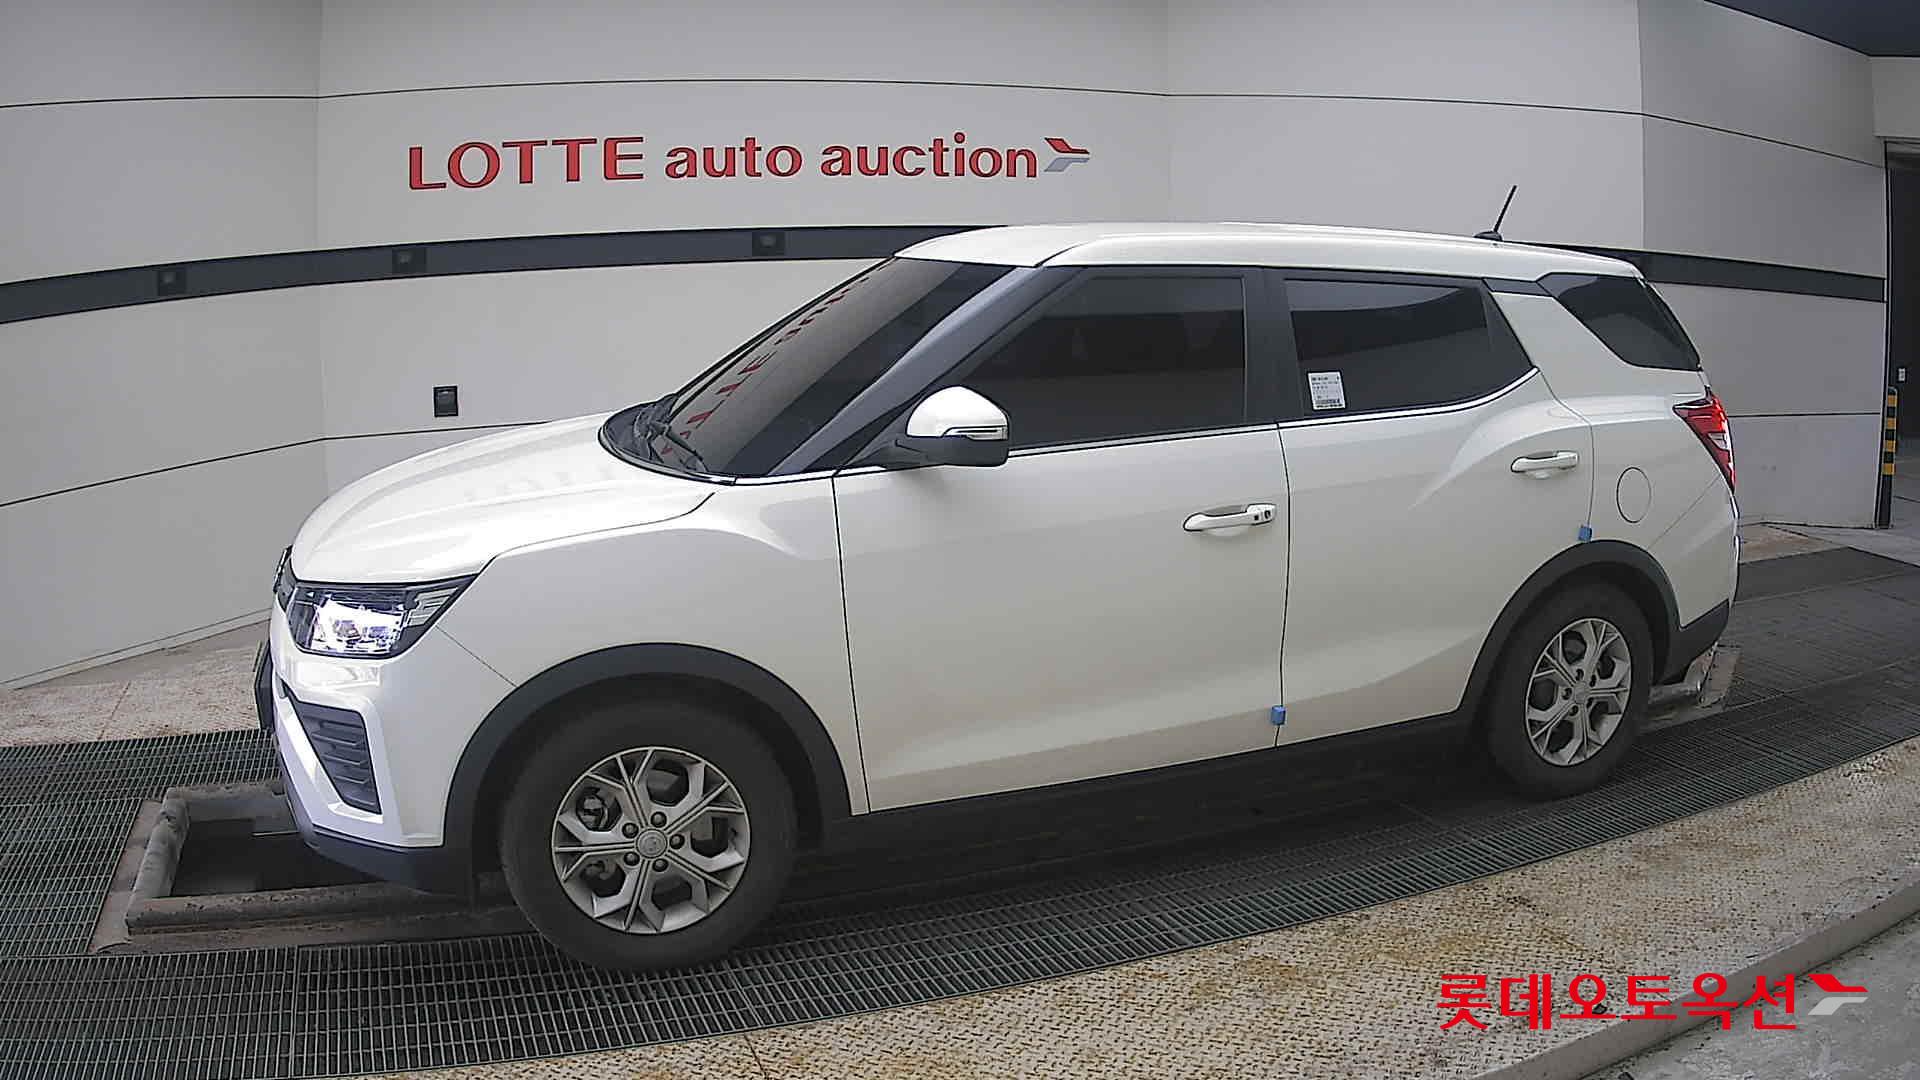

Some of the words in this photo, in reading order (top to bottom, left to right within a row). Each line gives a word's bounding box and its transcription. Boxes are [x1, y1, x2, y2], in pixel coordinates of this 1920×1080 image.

[409, 136, 644, 190] LOTTE
[665, 137, 802, 178] auto
[820, 132, 1037, 178] auction
